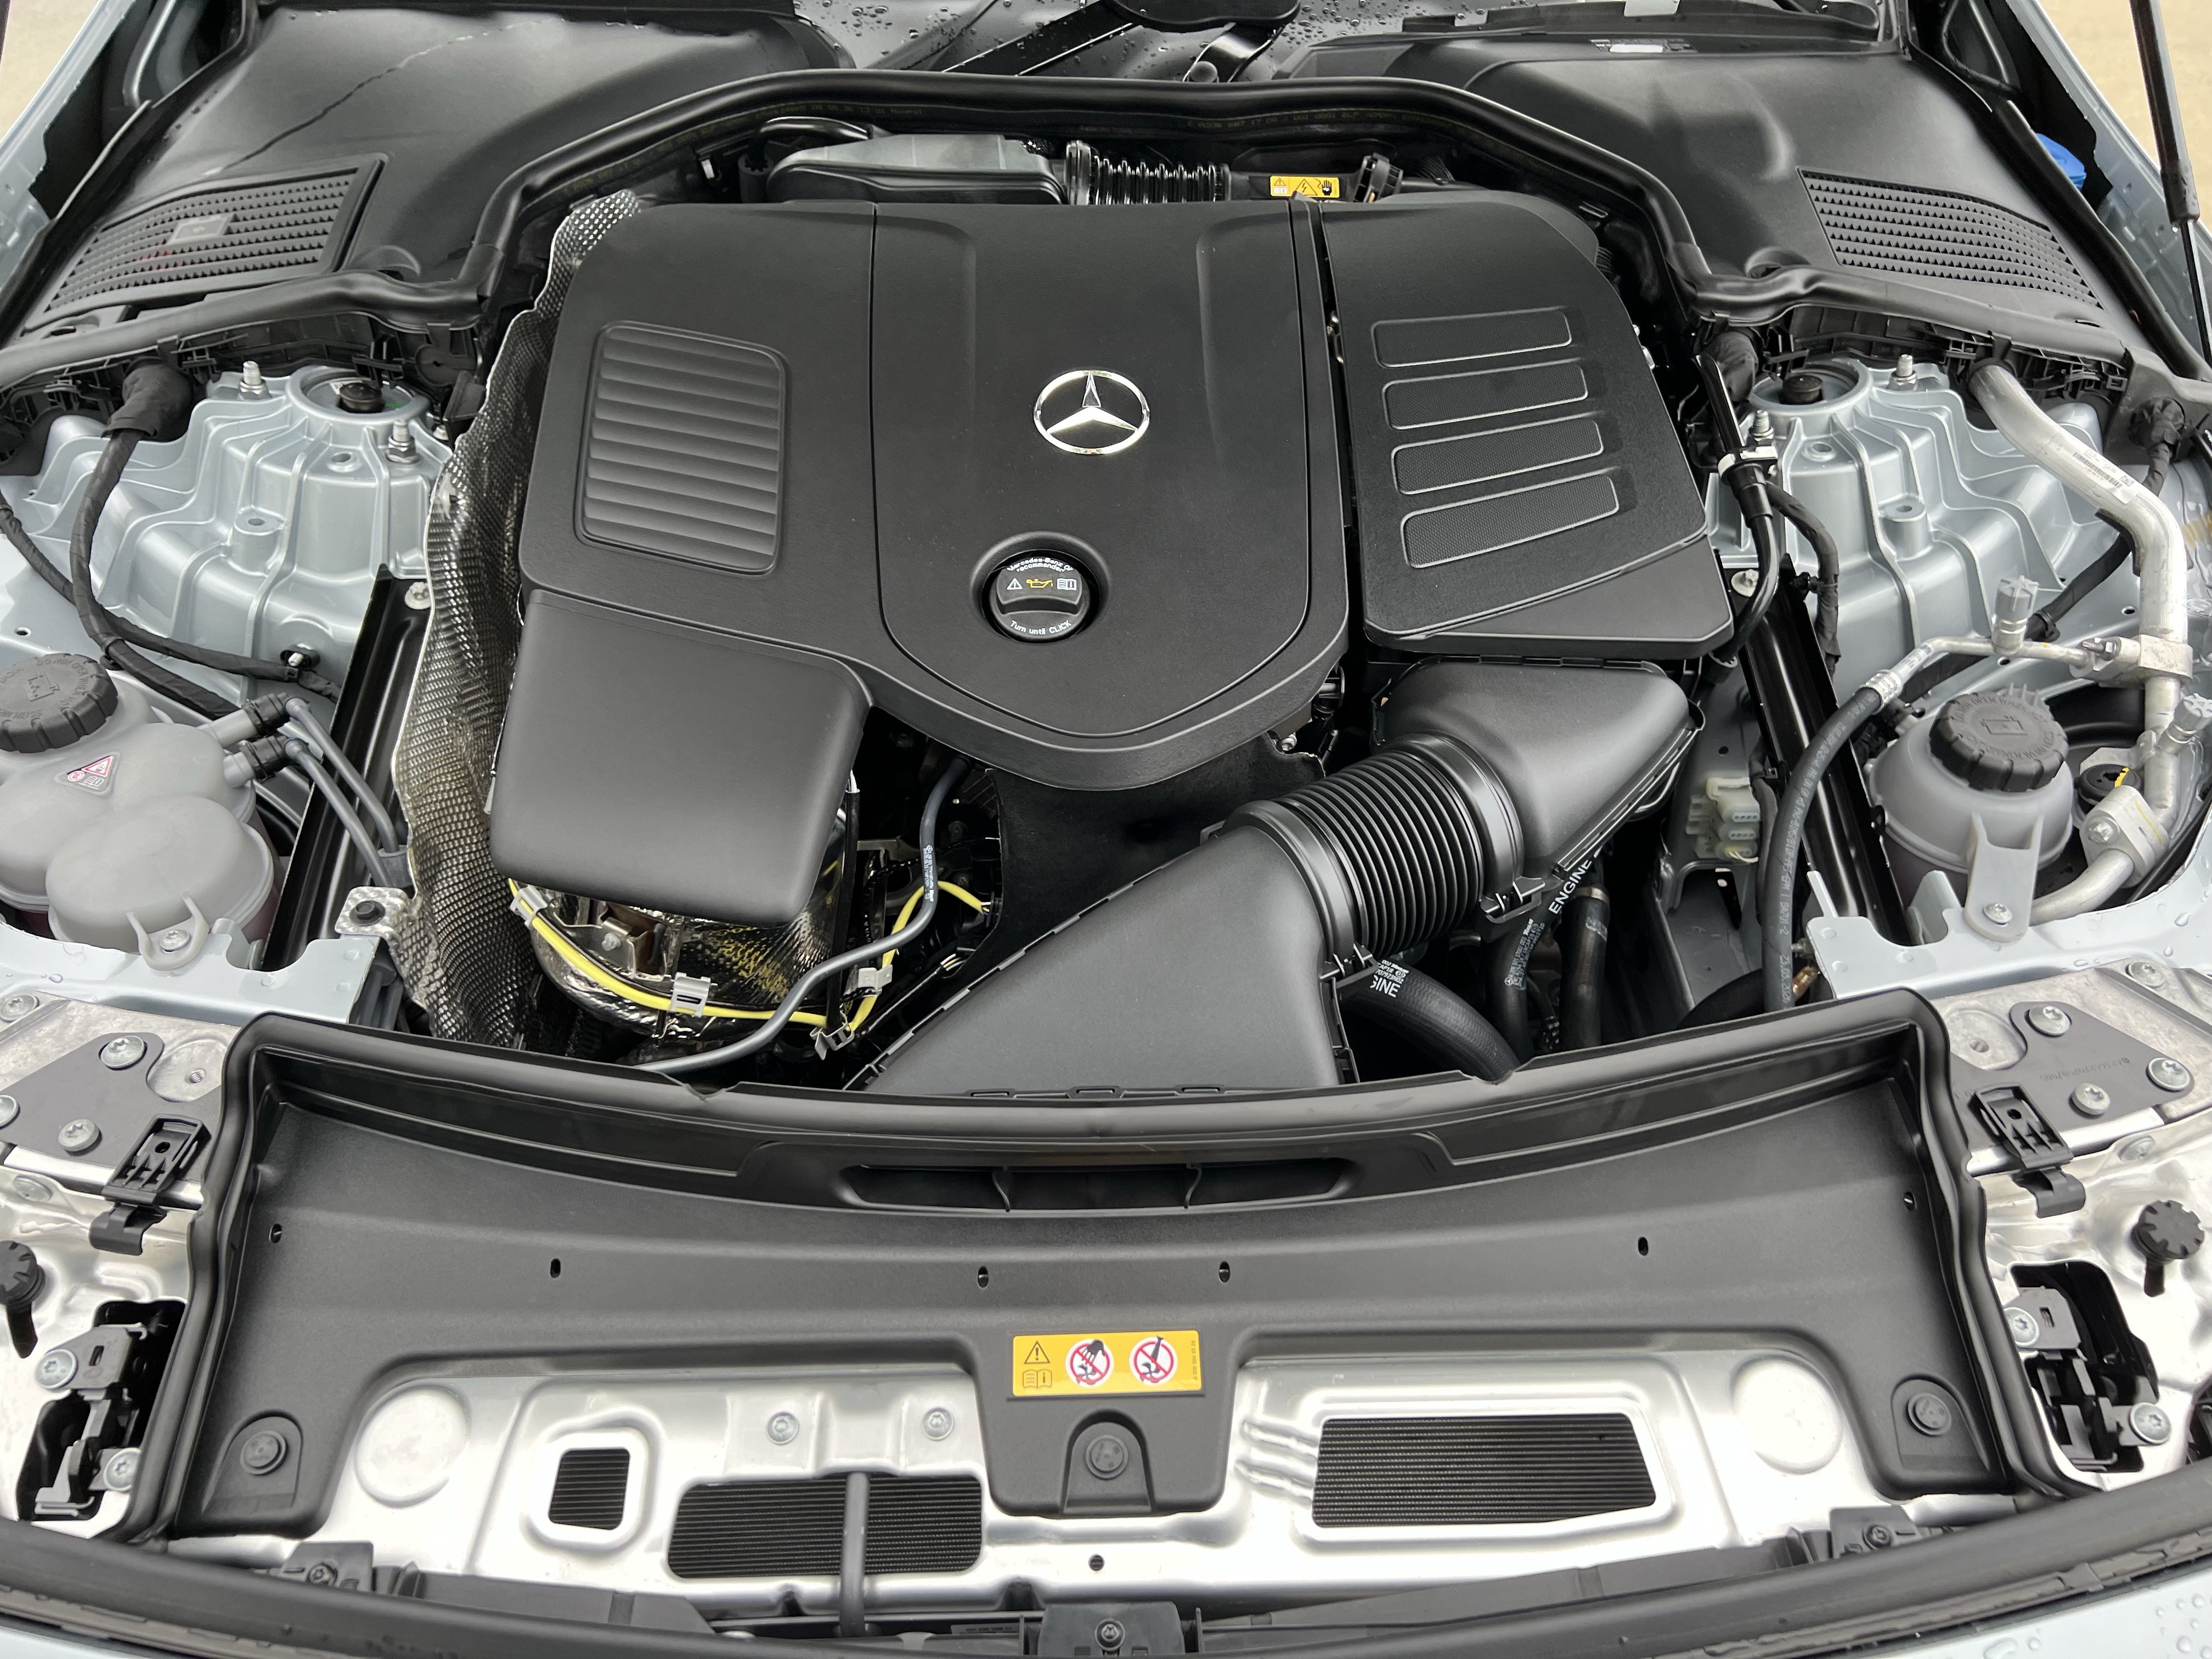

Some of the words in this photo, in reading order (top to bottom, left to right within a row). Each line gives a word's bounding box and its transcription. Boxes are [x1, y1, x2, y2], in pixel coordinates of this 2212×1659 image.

[1007, 557, 1064, 571] Mercedes-Benz
[1010, 620, 1026, 633] Turn
[1048, 619, 1072, 634] CLICK
[1548, 859, 1592, 915] ENGINE
